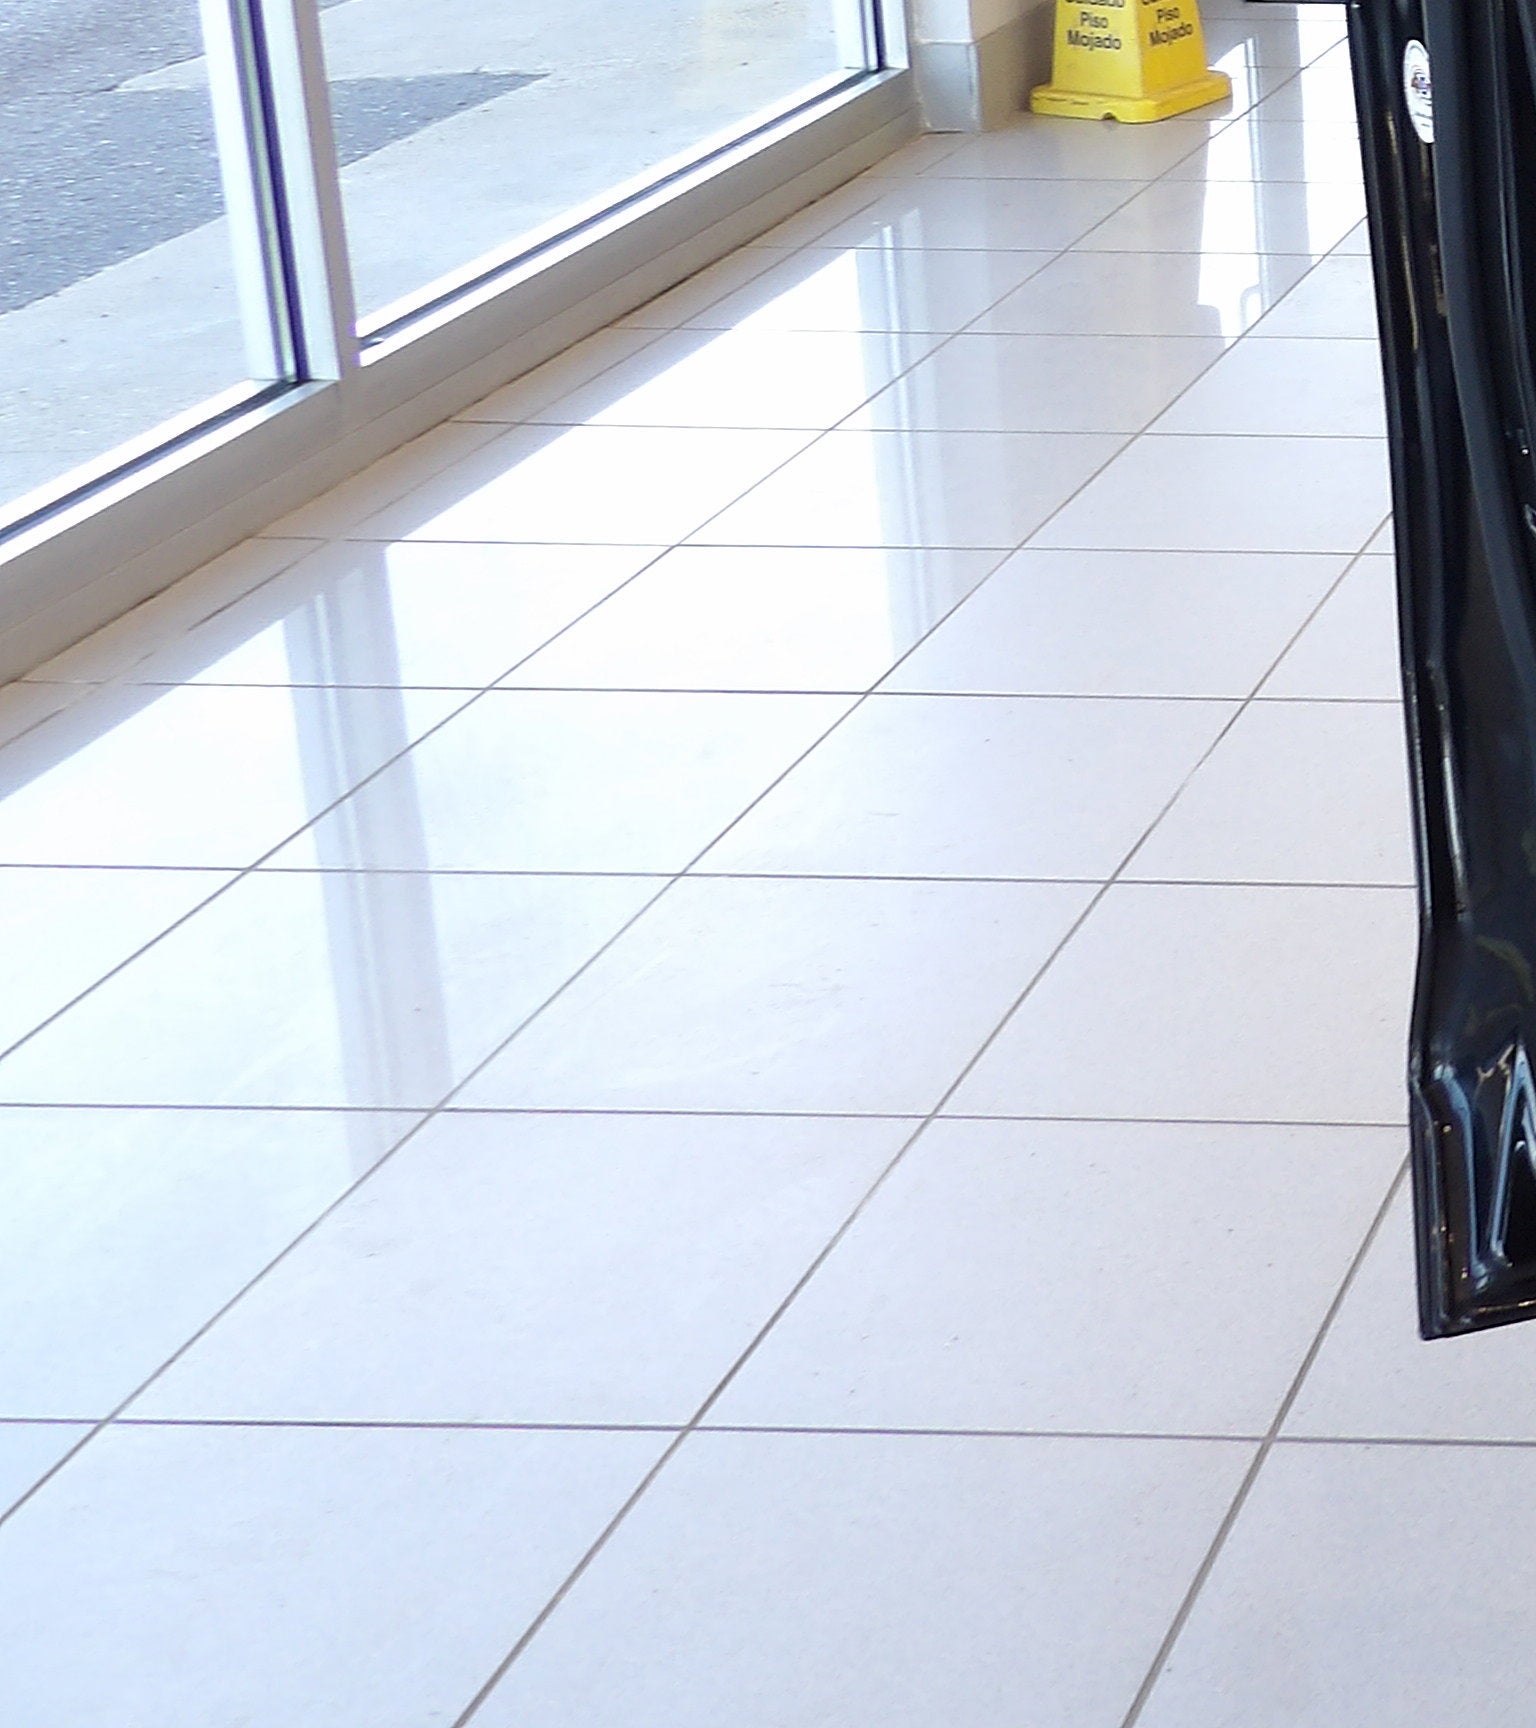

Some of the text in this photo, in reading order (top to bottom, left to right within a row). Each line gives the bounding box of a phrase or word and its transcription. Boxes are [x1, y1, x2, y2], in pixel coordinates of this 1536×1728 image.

[1080, 11, 1109, 29] Piso
[1156, 6, 1180, 23] Piso
[1066, 29, 1122, 51] Mojado
[1148, 22, 1193, 46] Mojado
